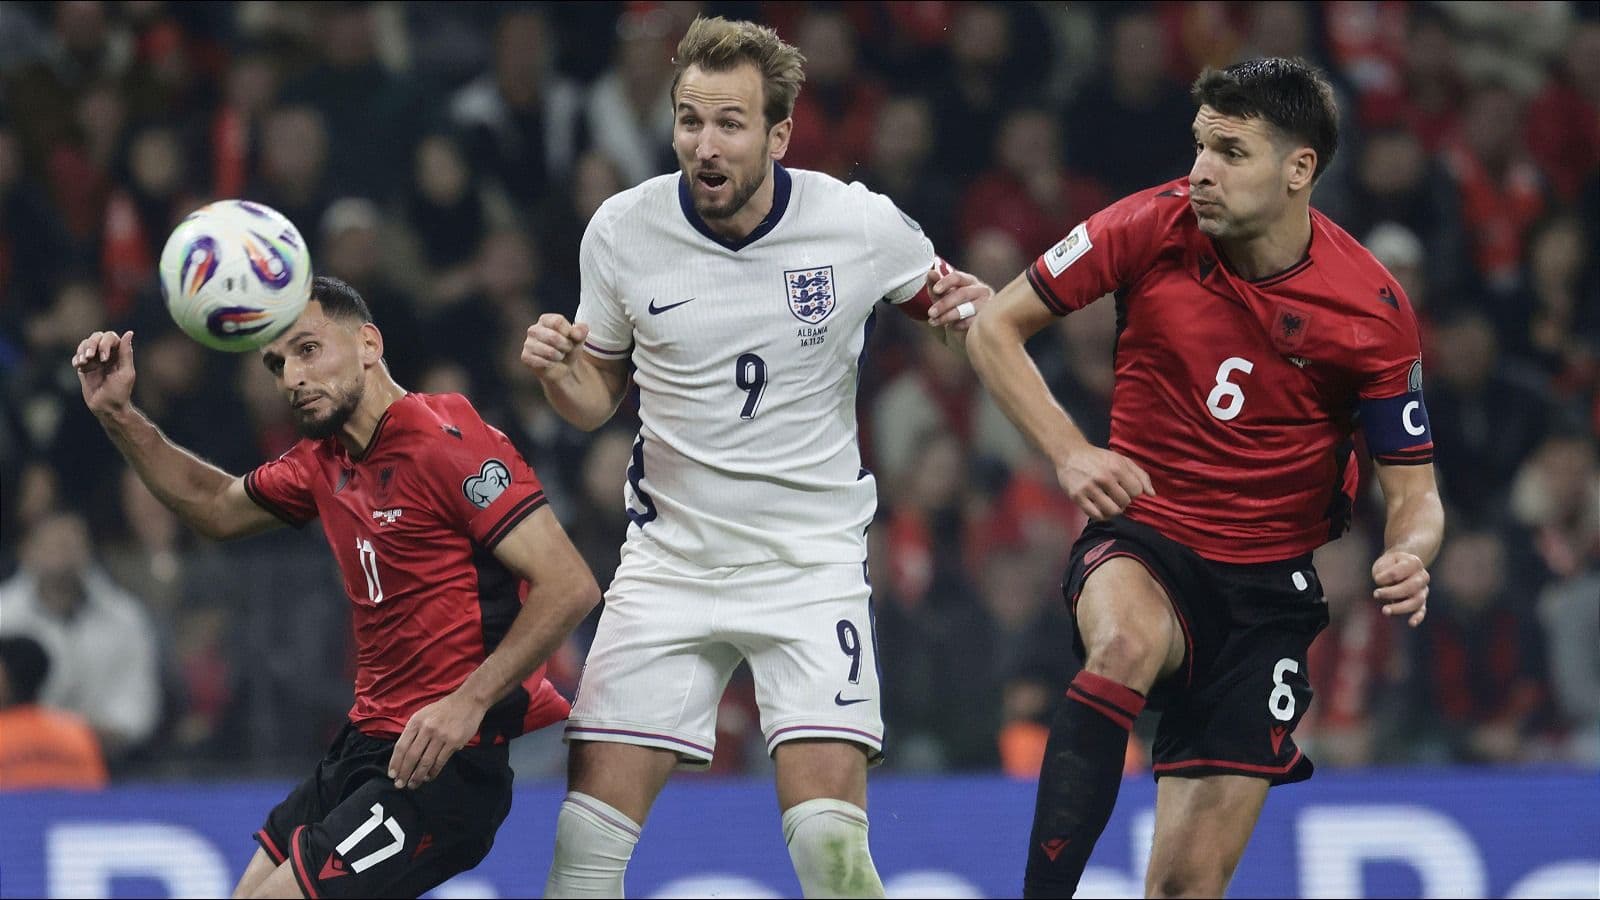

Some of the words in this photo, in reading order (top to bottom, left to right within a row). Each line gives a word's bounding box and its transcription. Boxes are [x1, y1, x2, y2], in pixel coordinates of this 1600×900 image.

[797, 326, 828, 337] ALBANIA
[735, 353, 768, 420] 9
[1206, 356, 1254, 420] 6
[1402, 400, 1426, 436] C
[836, 619, 863, 685] 9
[1268, 657, 1299, 721] 6
[335, 802, 406, 874] 17
